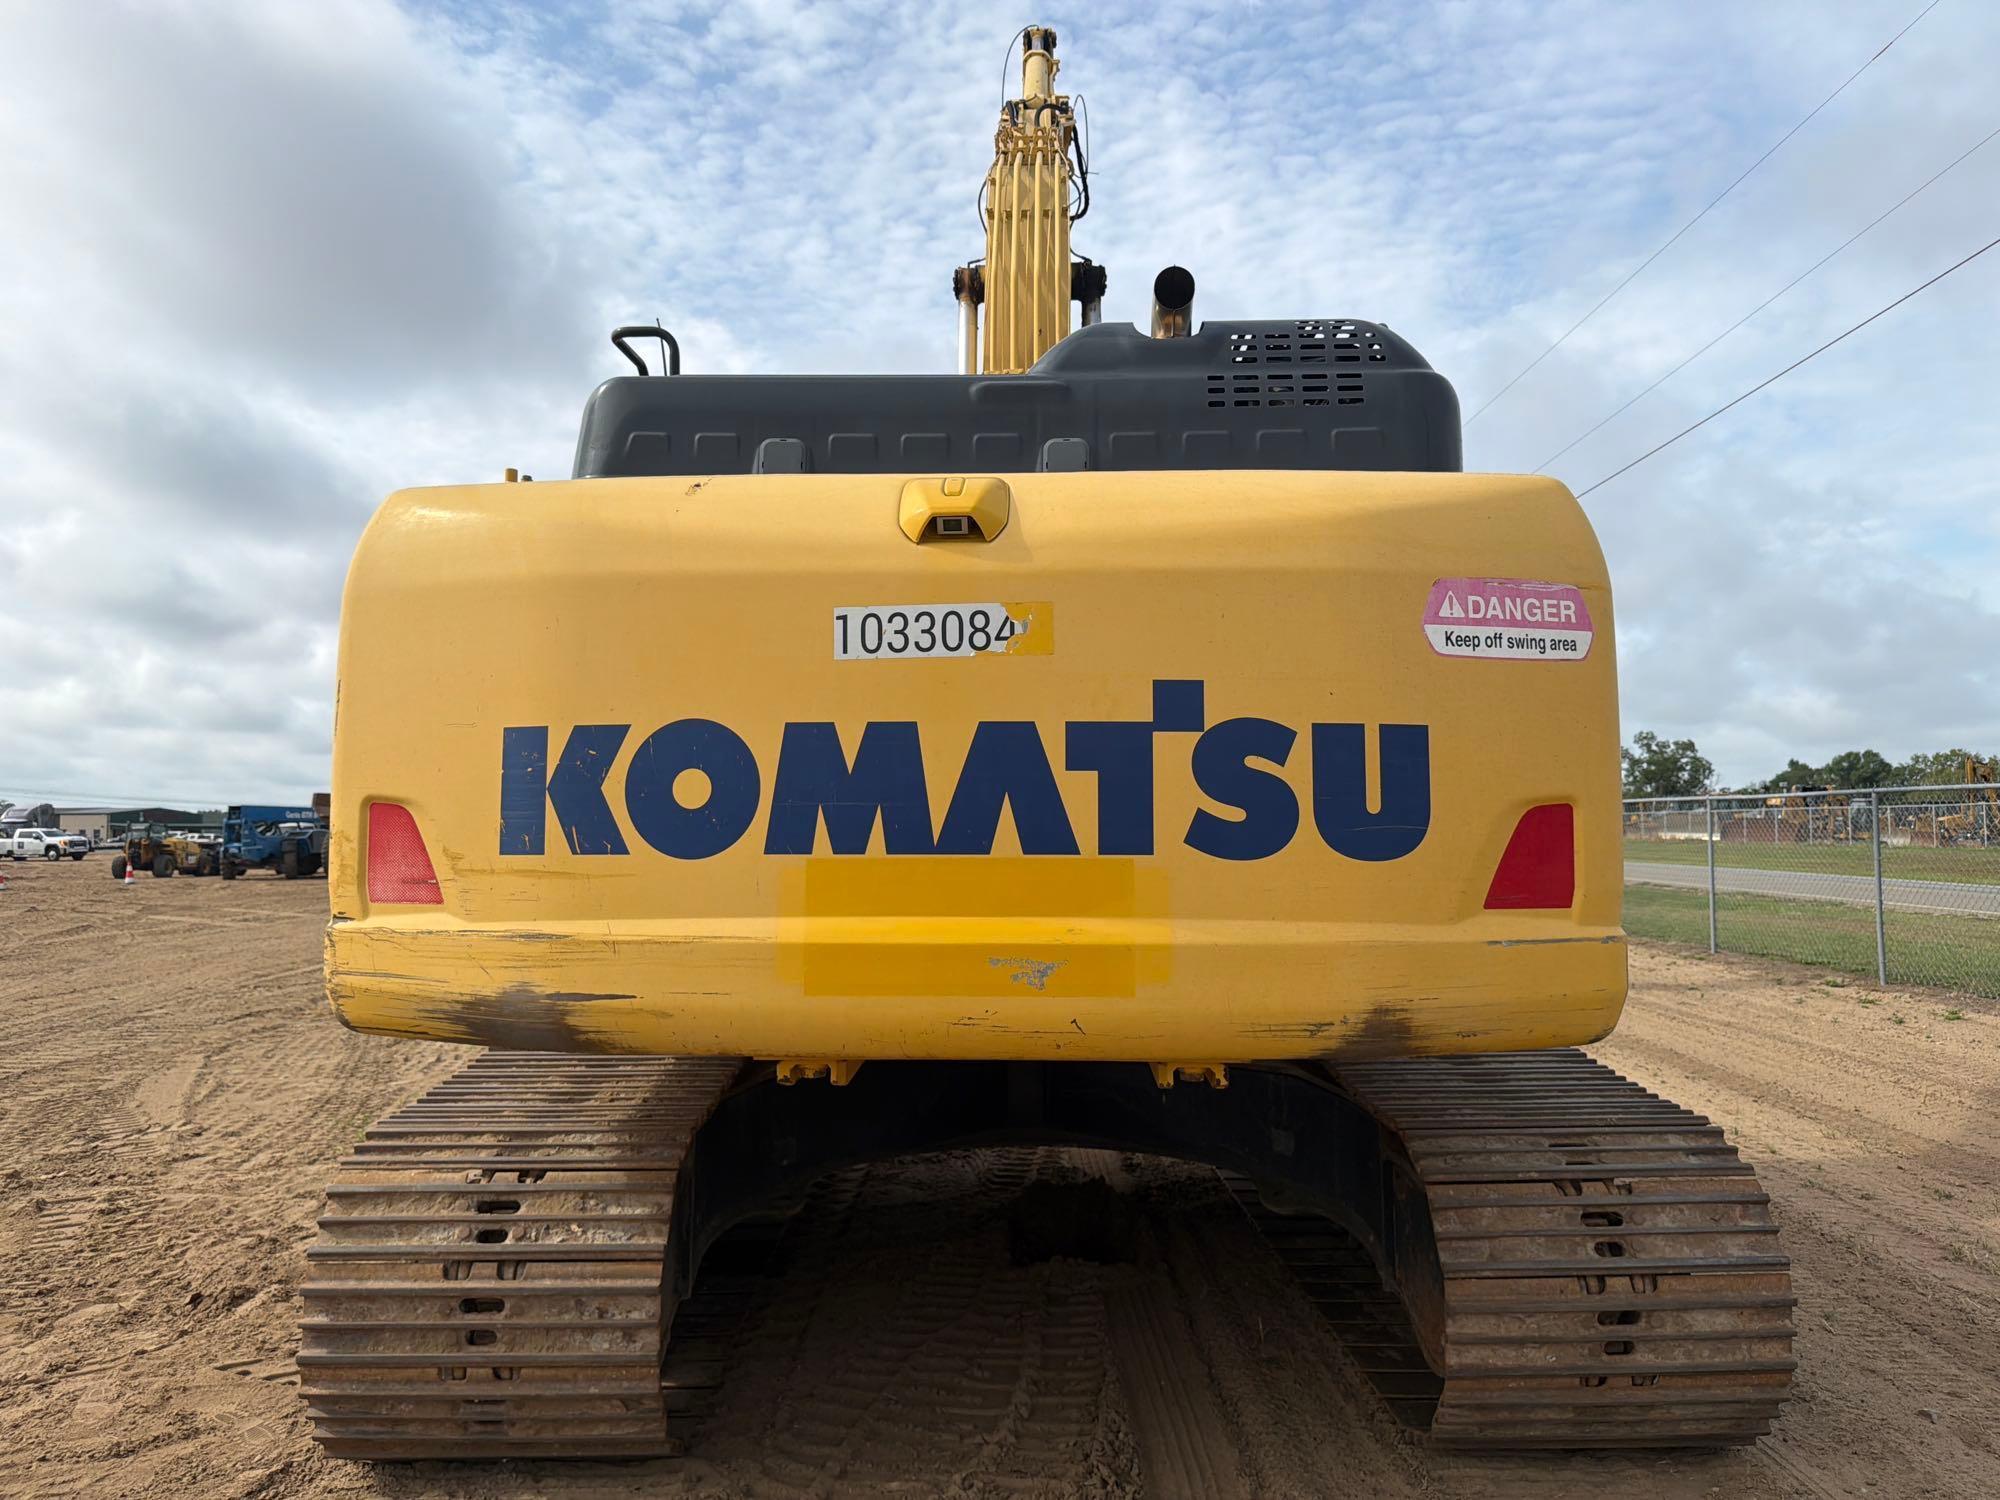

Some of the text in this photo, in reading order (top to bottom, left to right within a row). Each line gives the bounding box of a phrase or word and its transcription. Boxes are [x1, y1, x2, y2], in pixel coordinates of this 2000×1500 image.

[1467, 595, 1577, 623] DANGER
[1444, 630, 1577, 654] Keep off swing area
[499, 679, 1431, 862] KOMATSU
